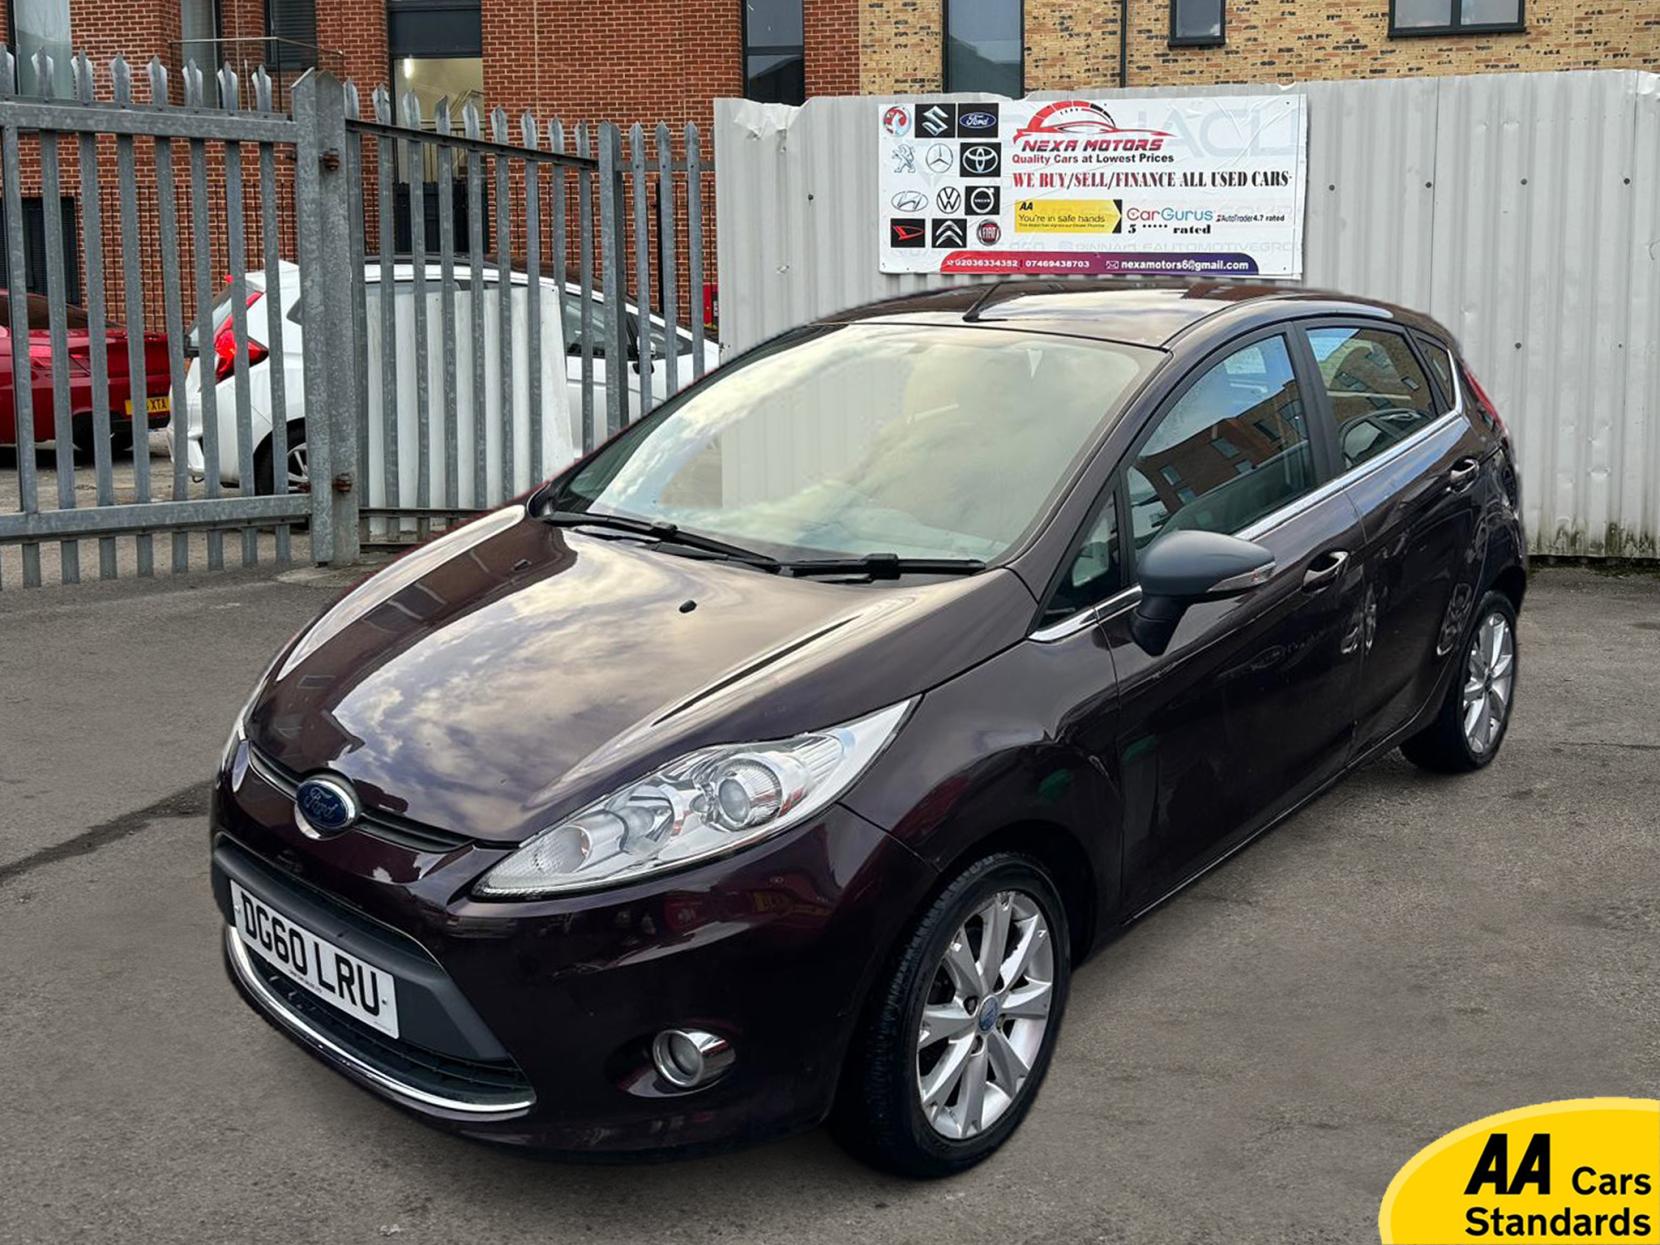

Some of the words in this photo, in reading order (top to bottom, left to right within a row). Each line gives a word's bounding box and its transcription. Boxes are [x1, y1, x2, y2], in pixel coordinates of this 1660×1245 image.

[1021, 139, 1079, 152] NEXA
[1083, 138, 1164, 152] MOTORS
[1012, 153, 1050, 165] Quality
[1054, 153, 1079, 164] Cars
[1082, 154, 1093, 163] at
[1096, 153, 1136, 163] Lowest
[1139, 152, 1175, 163] Prices
[1012, 172, 1036, 187] WE
[1180, 171, 1208, 187] ALL
[1211, 171, 1248, 187] USED
[1019, 202, 1034, 211] AA
[1018, 214, 1046, 222] You're
[1047, 214, 1056, 222] in
[1058, 213, 1077, 222] safe
[1078, 213, 1106, 223] hands
[1126, 207, 1214, 221] CarGurus
[1265, 214, 1285, 222] rated
[1127, 224, 1137, 234] 5
[1172, 223, 1212, 235] rated
[304, 786, 339, 818] Ford
[241, 891, 308, 976] DG60
[314, 941, 380, 1017] LRU
